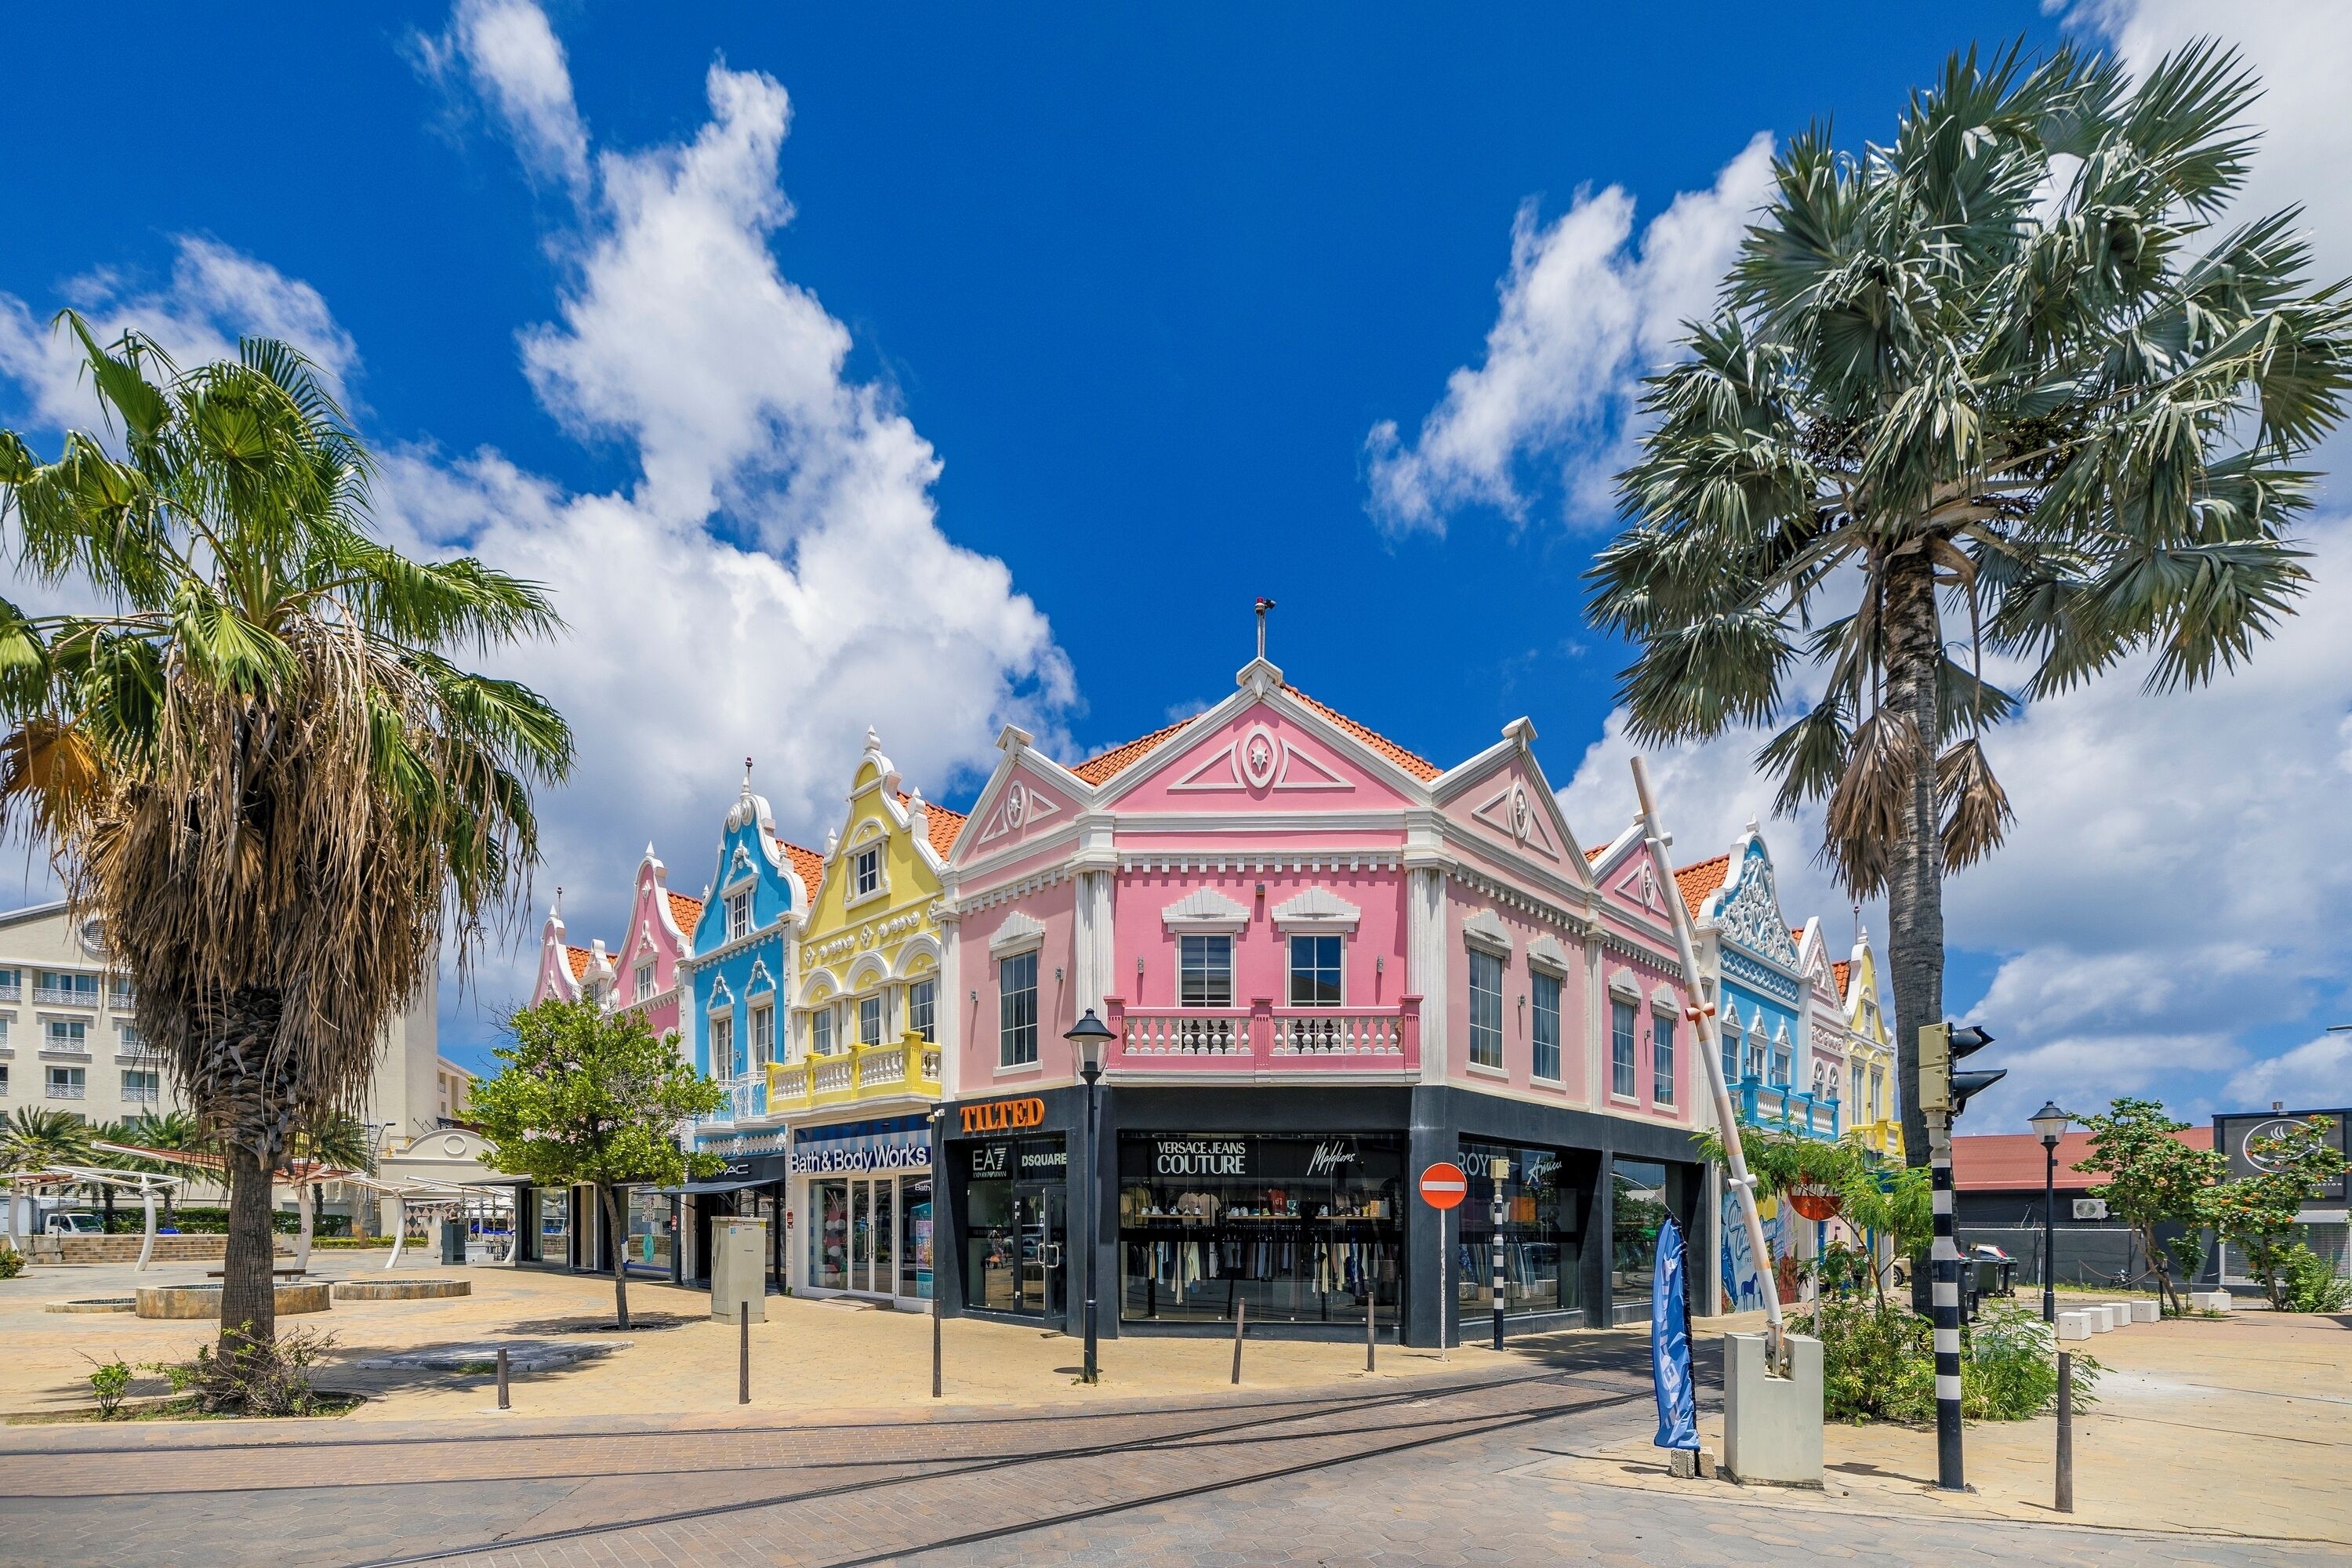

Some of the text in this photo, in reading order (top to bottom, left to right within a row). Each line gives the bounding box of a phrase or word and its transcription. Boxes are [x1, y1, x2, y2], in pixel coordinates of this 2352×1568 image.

[960, 1098, 1045, 1133] TILTED
[790, 1142, 927, 1174] Bath & Body Works
[973, 1147, 1007, 1171] EA7
[1157, 1142, 1246, 1154] VERSACE JEANS
[1157, 1155, 1246, 1174] COUTURE
